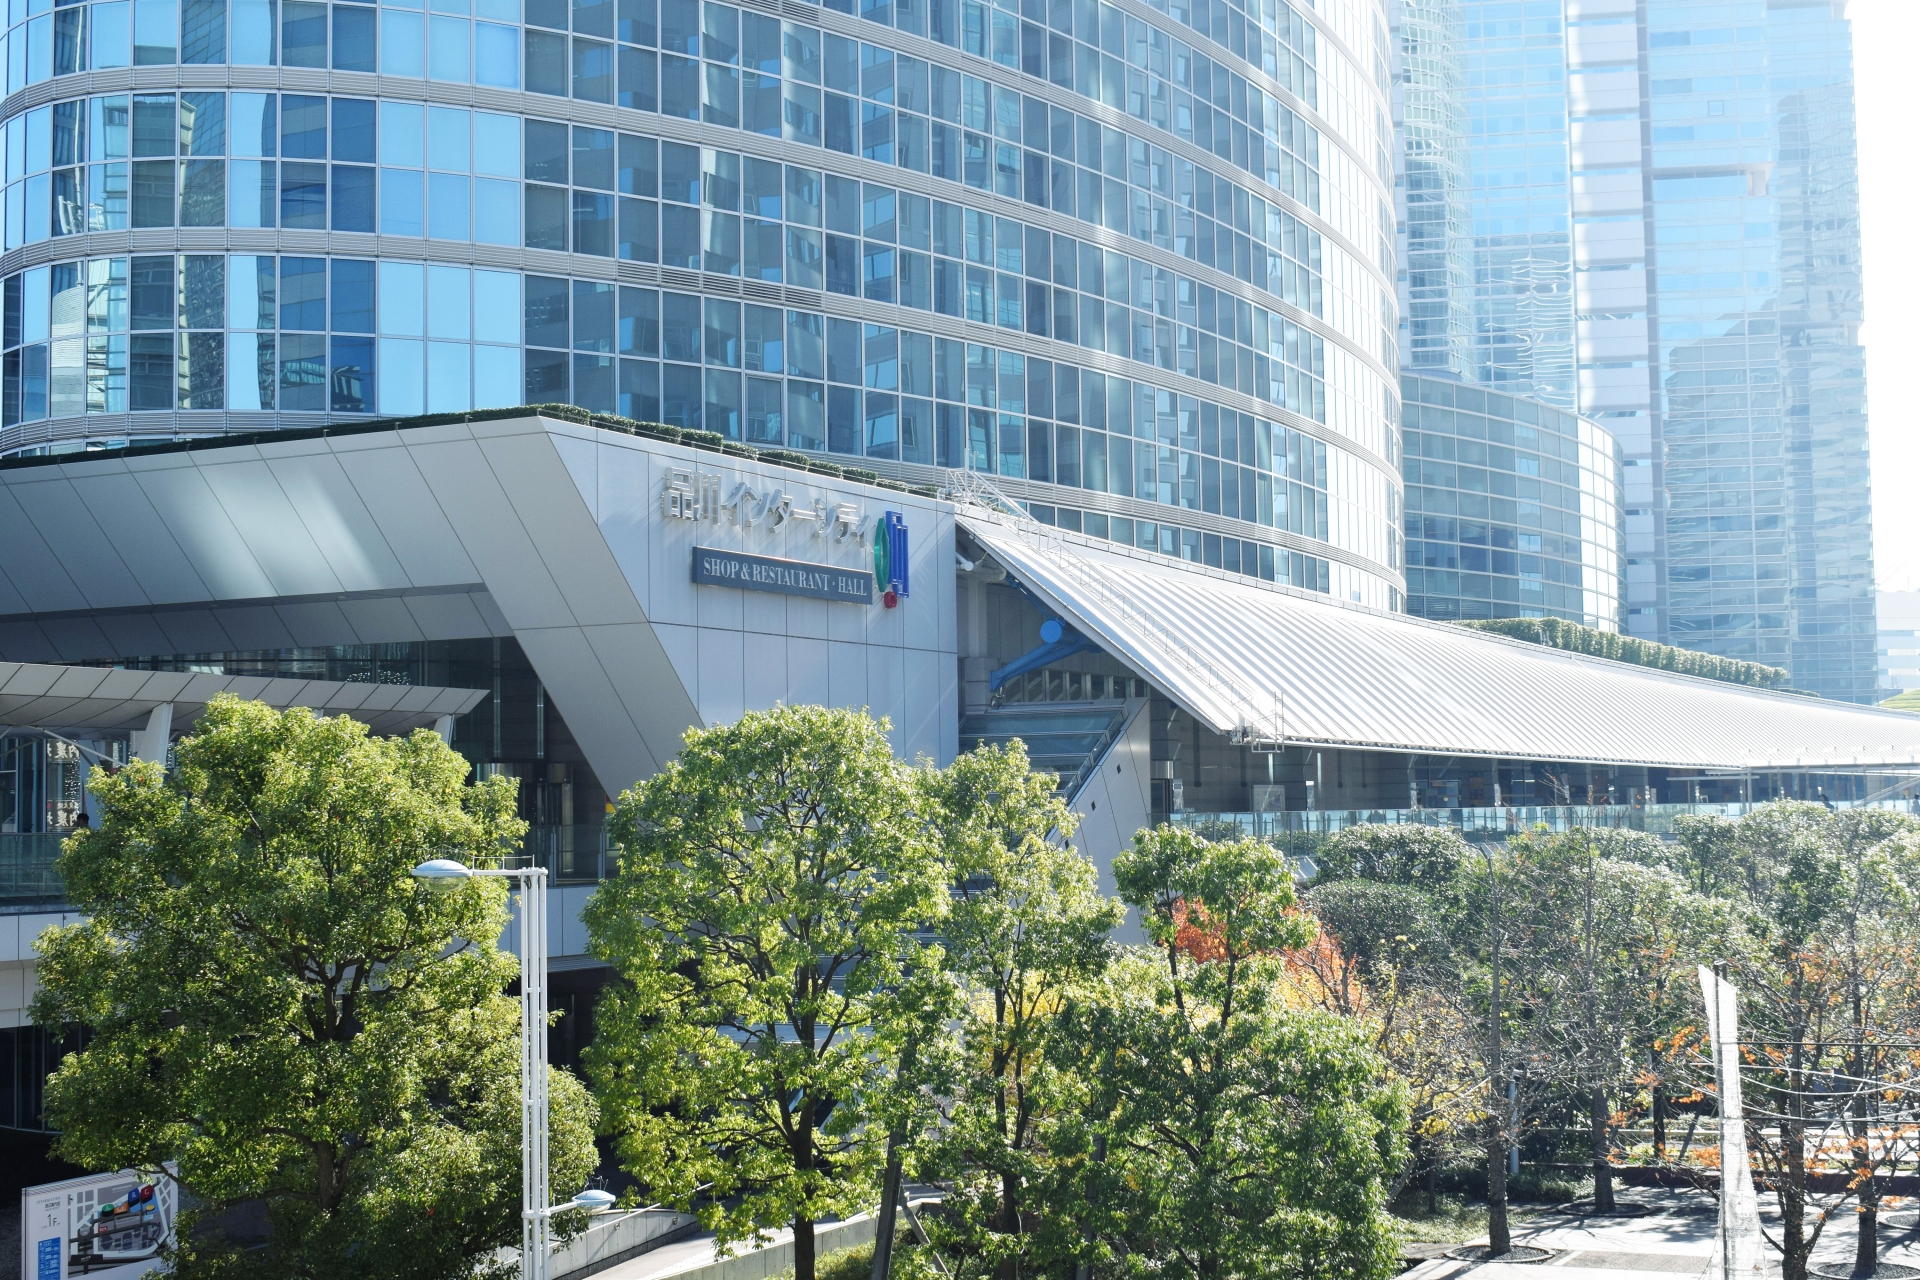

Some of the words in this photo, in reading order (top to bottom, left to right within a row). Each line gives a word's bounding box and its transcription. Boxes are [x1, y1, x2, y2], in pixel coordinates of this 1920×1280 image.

[661, 467, 872, 548] 品川インターシティ
[703, 557, 739, 579] SHOP
[752, 564, 830, 591] RESTAURANT
[837, 576, 867, 596] HALL
